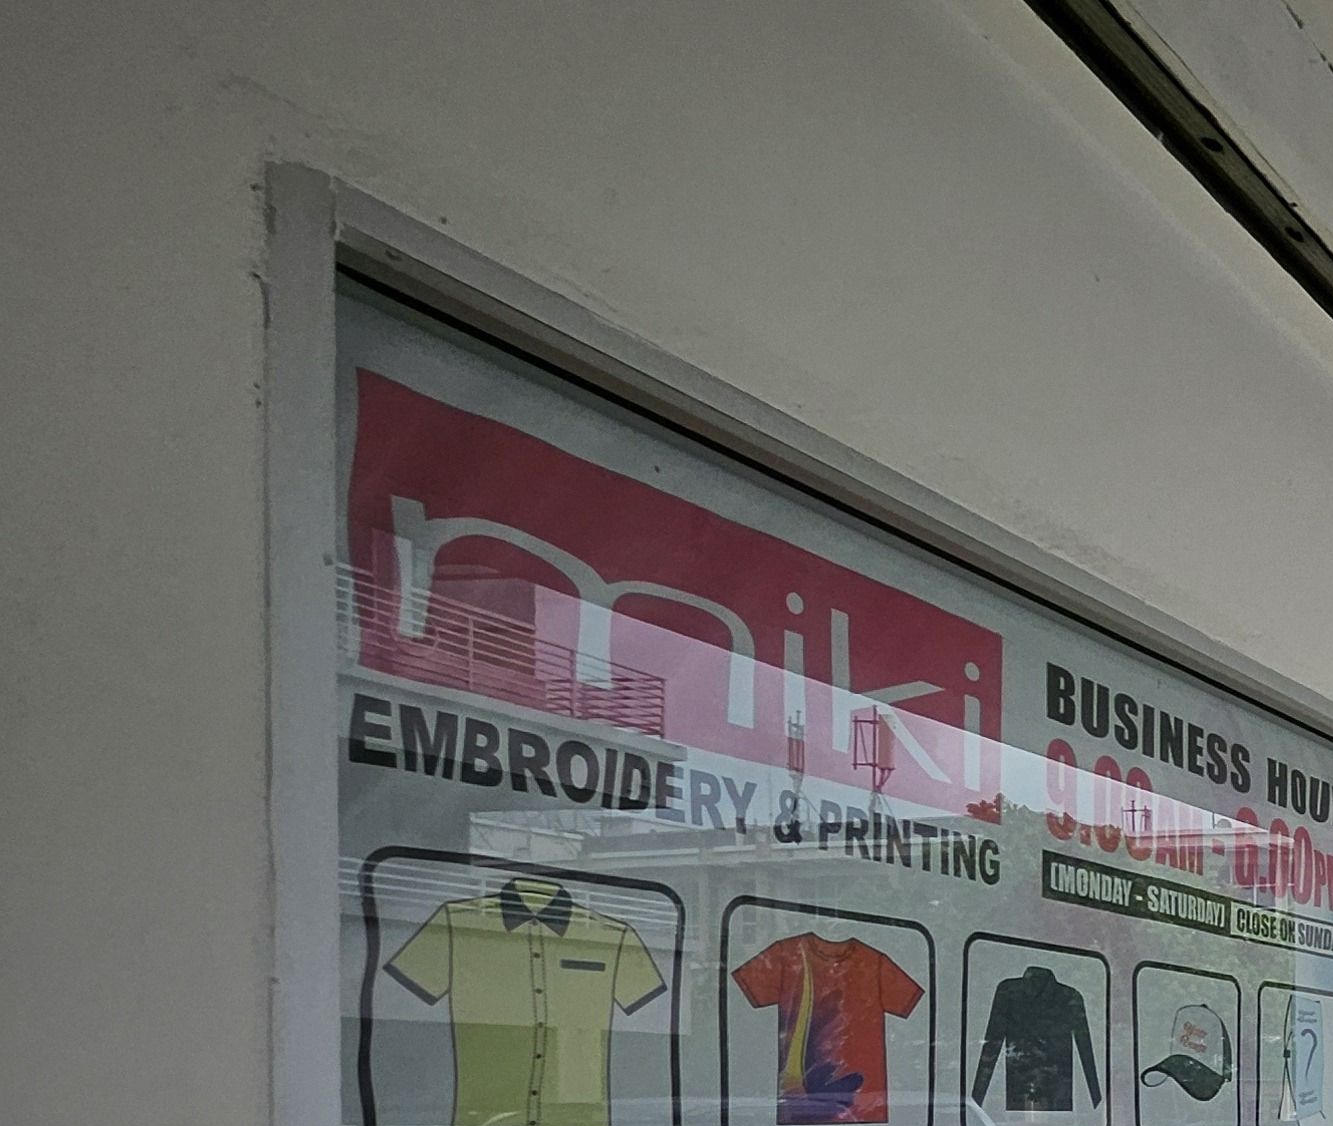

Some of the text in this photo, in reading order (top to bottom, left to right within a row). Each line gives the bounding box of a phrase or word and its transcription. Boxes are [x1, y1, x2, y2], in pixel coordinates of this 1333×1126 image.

[390, 494, 980, 793] miki
[348, 694, 1000, 886] EMBROIDERY & PRINTING
[1047, 662, 1251, 794] BUSINESS
[1236, 907, 1277, 940] CLOSE
[1280, 918, 1296, 943] ON
